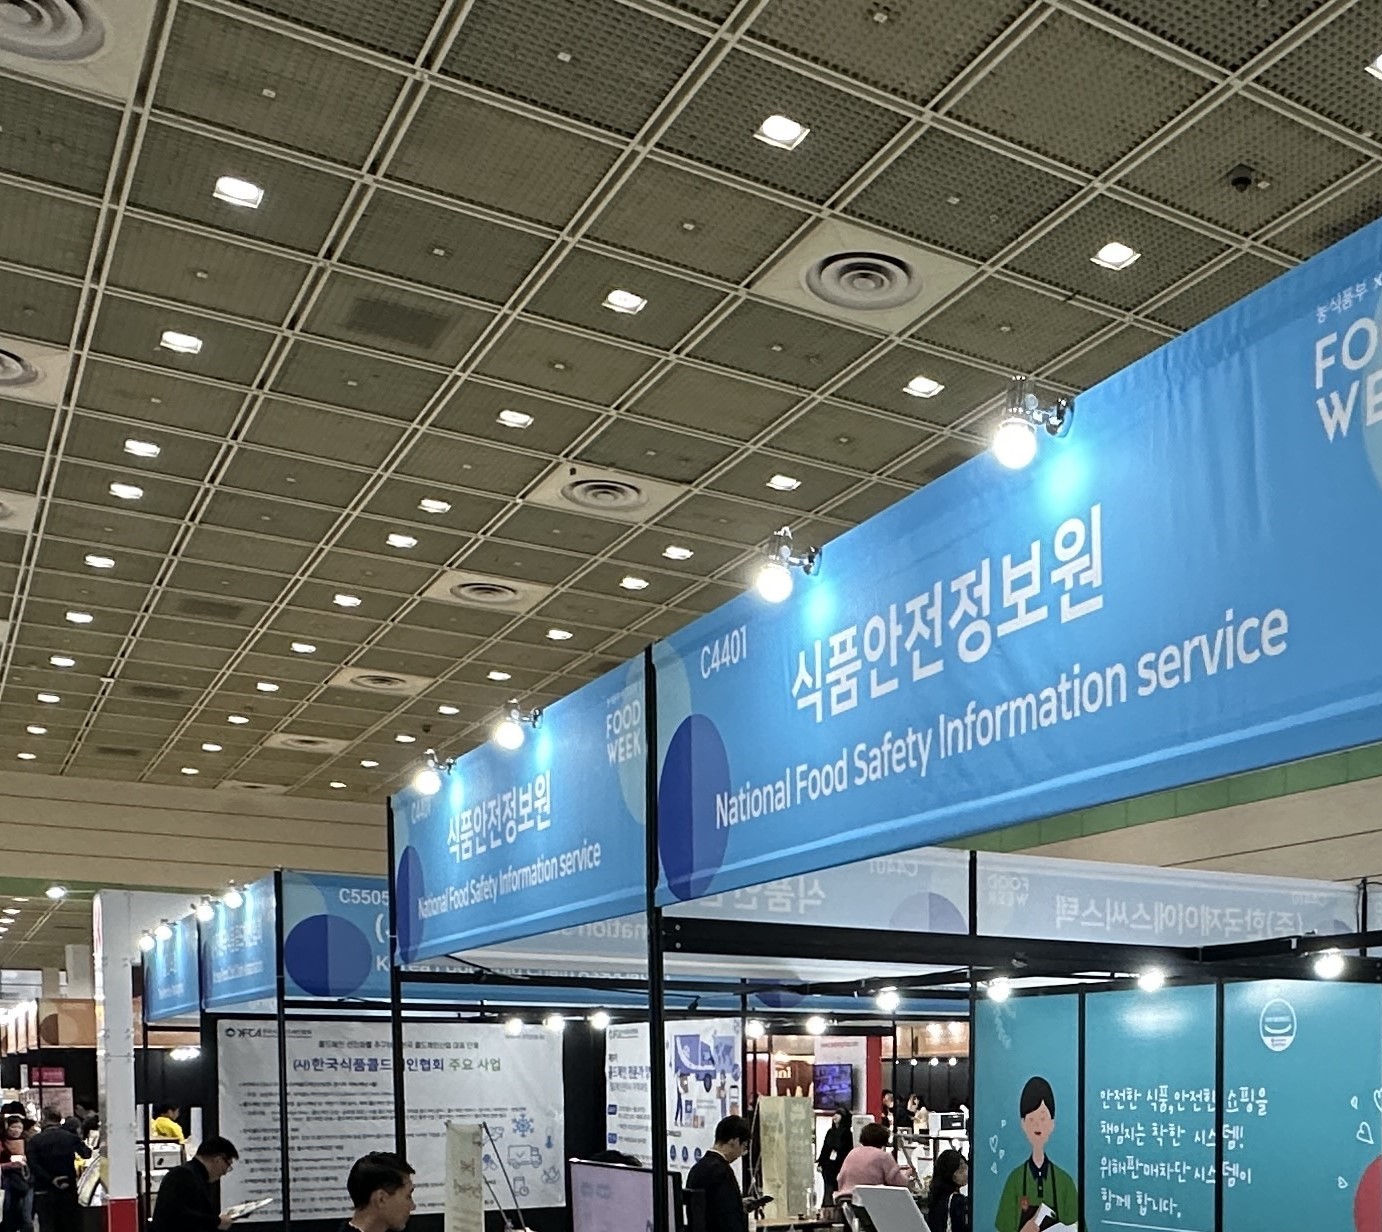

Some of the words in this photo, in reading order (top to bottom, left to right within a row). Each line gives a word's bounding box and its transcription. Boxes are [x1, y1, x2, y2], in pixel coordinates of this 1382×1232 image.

[791, 504, 1105, 723] 식품안전정보원
[700, 625, 747, 679] C4401
[606, 700, 641, 738] FOOD
[716, 768, 790, 830] National
[796, 747, 847, 805] Food
[853, 727, 932, 786] Safety
[938, 657, 1126, 760] Information
[1137, 606, 1289, 690] service
[607, 727, 641, 766] WEEK
[447, 770, 551, 864] 식품안전정보원
[418, 889, 449, 920] National
[449, 880, 469, 910] Food
[470, 875, 499, 904] Safety
[499, 852, 558, 896] Information
[559, 837, 601, 878] service
[293, 1057, 444, 1074] (사)한국식품콜드인협회
[448, 1058, 474, 1072] 주요
[477, 1058, 501, 1072] 사업
[1100, 1087, 1142, 1111] 안전한
[1174, 1088, 1217, 1112] 안전한
[1225, 1086, 1269, 1116] 쇼핑을
[1100, 1120, 1146, 1146] 책임지는
[1152, 1122, 1186, 1147] 착한
[1194, 1123, 1244, 1150] 시스템!
[1100, 1156, 1191, 1183] 위해판매차단
[1194, 1161, 1251, 1187] 시스템이
[1100, 1188, 1131, 1211] 함께
[1136, 1191, 1182, 1218] 합니다.
